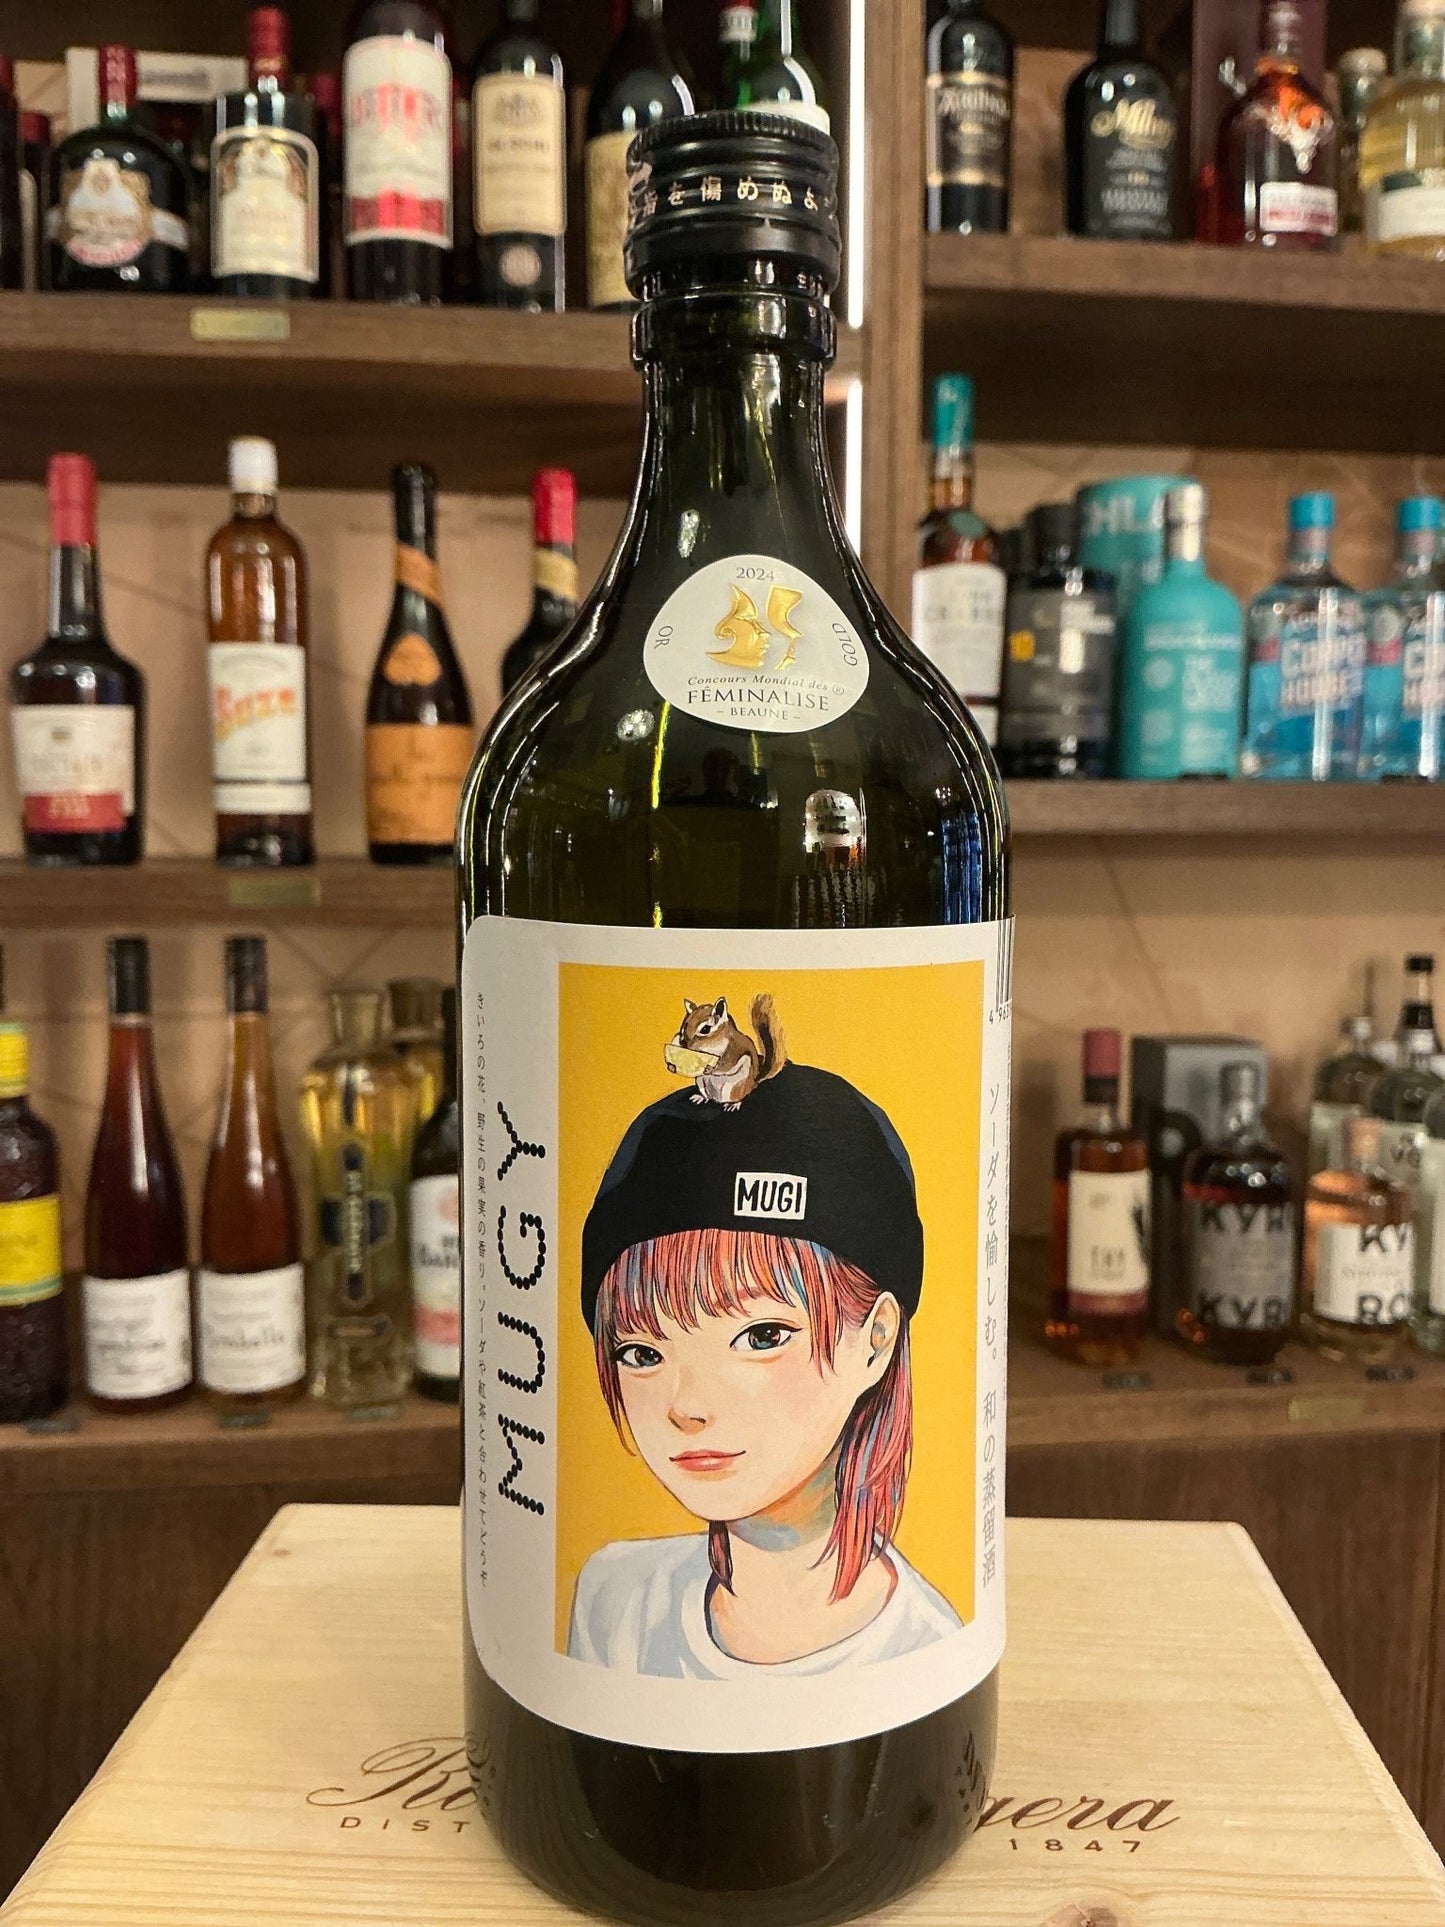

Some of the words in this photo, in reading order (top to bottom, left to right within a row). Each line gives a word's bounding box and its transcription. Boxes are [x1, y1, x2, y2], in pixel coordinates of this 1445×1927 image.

[736, 566, 776, 582] 2024
[654, 624, 674, 649] OR
[831, 622, 859, 667] GOLD
[687, 675, 747, 686] Concours
[752, 673, 804, 687] Mondial
[808, 678, 829, 692] des
[687, 686, 829, 712] FÉMINALISE
[730, 706, 789, 720] BEAUNE
[737, 1177, 803, 1214] MUGI
[498, 1101, 547, 1516] MUGY
[1008, 1837, 1141, 1853] 1847
